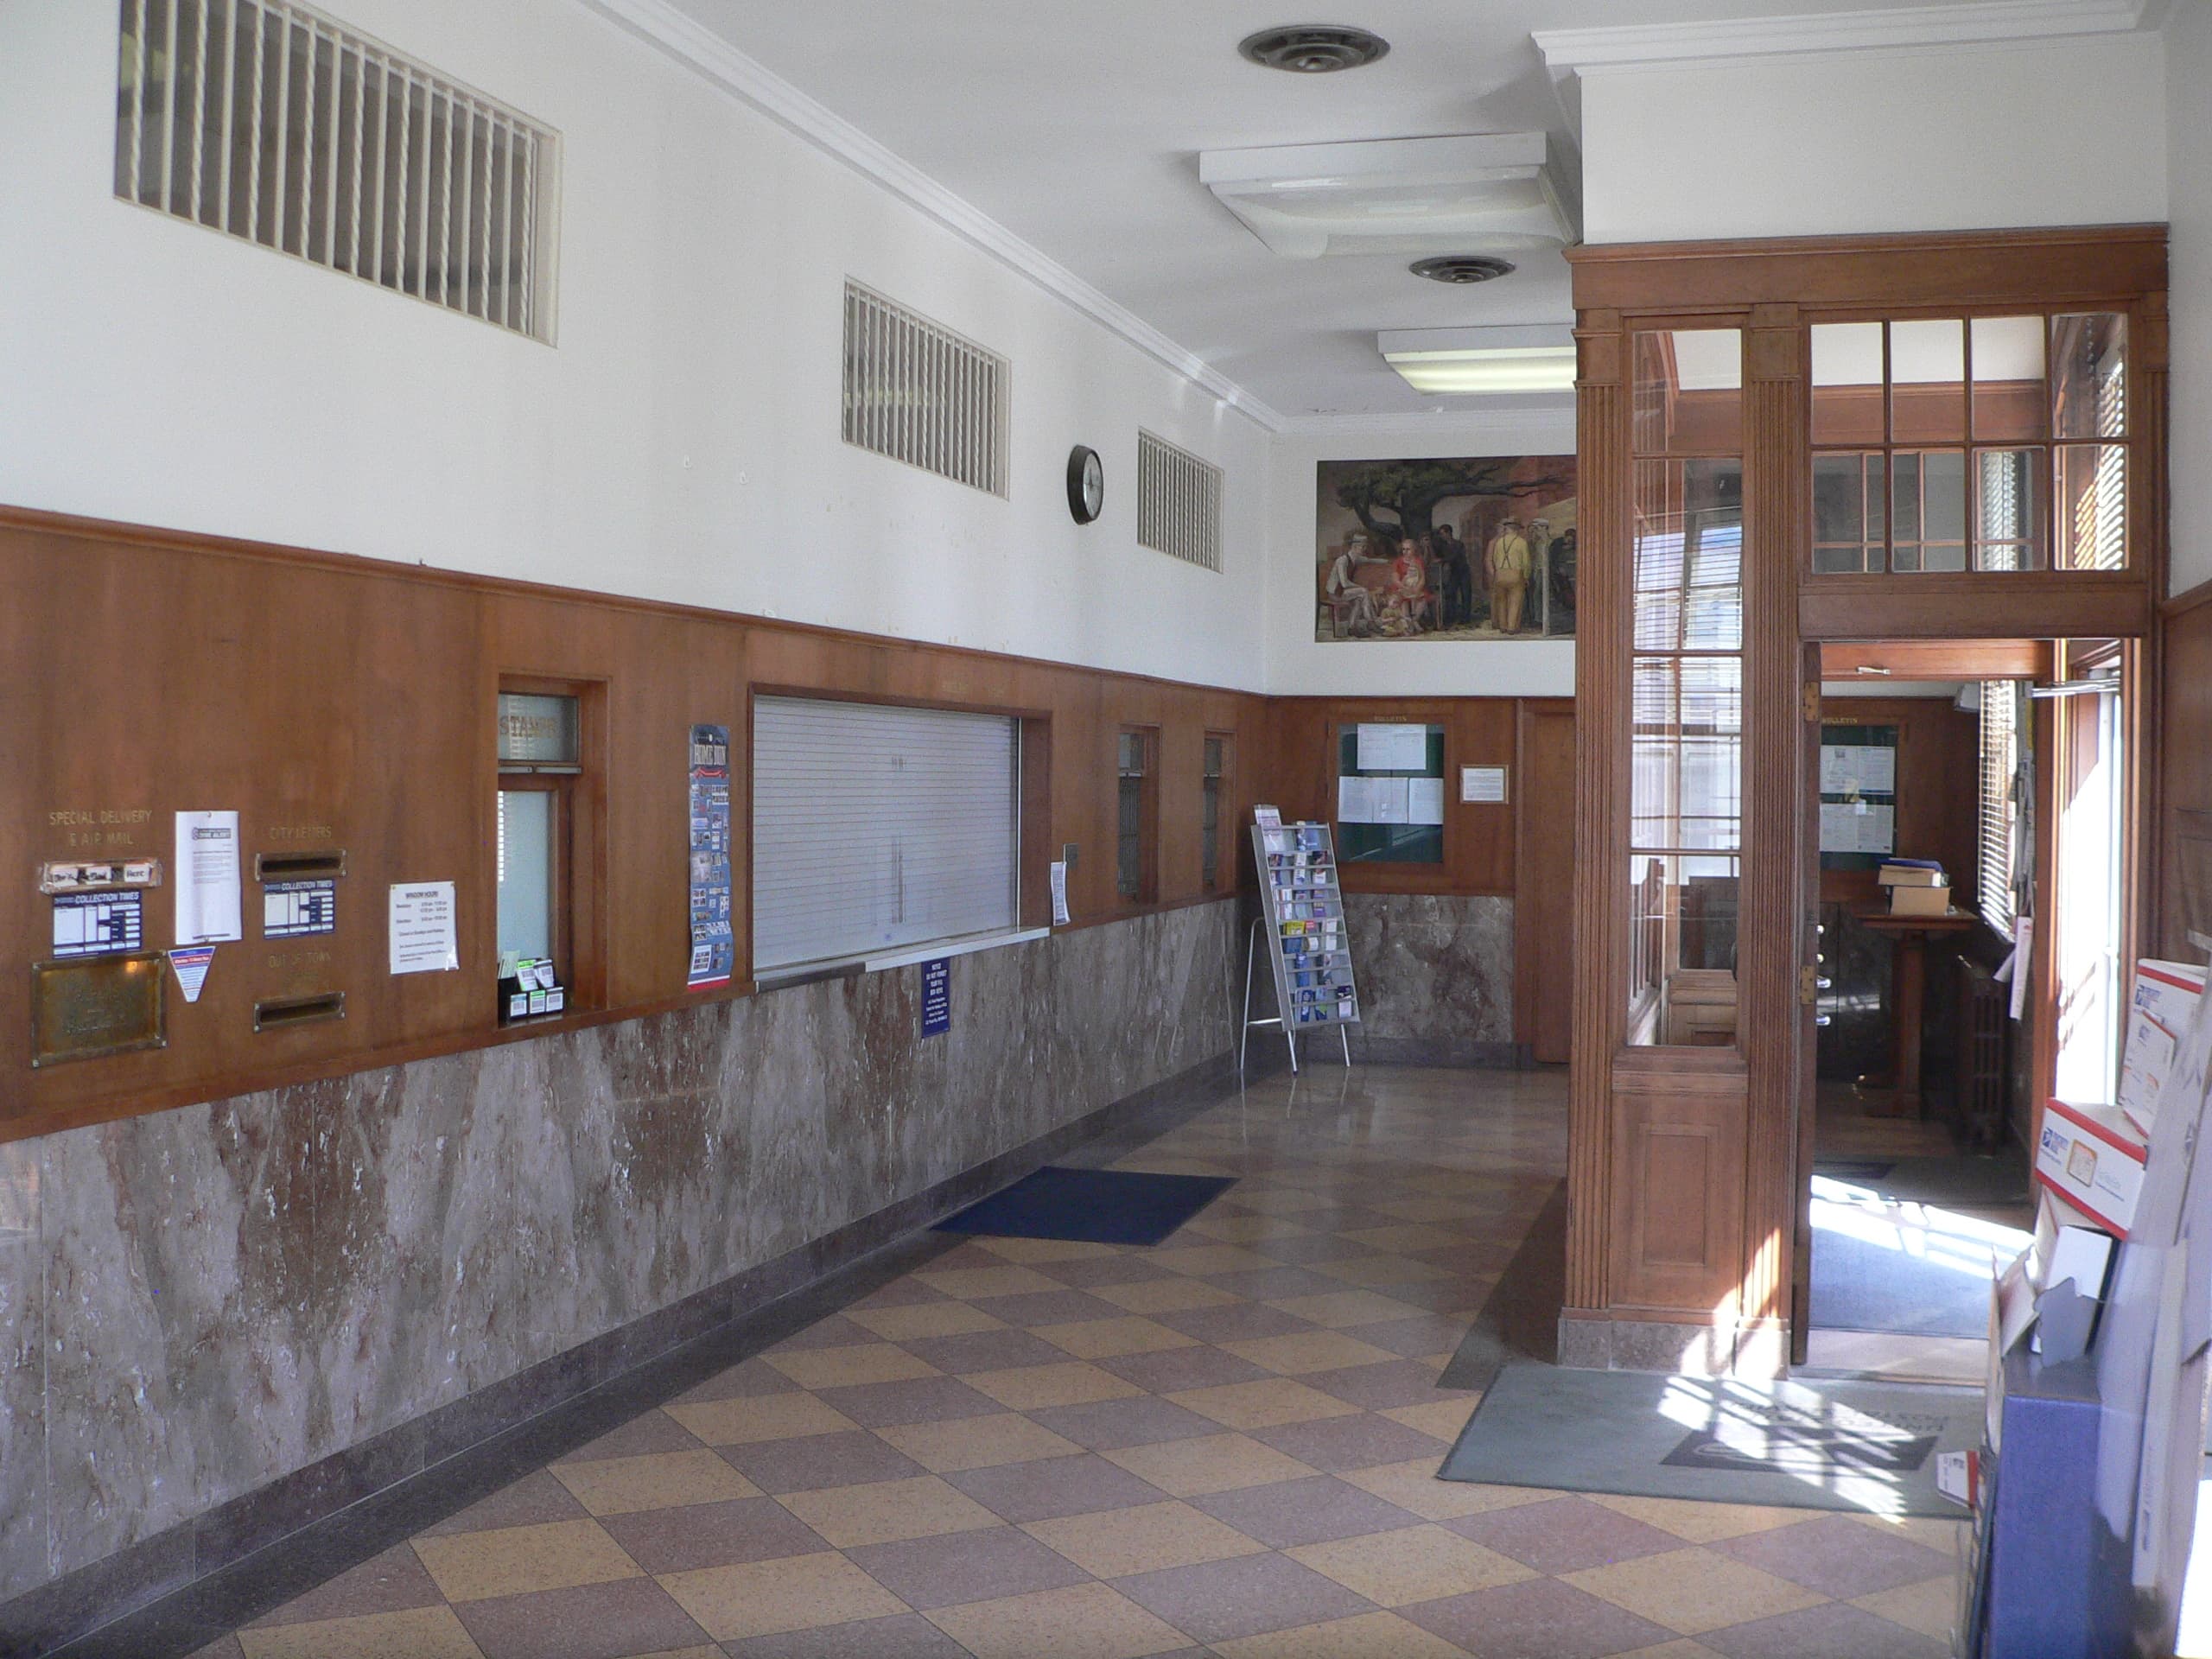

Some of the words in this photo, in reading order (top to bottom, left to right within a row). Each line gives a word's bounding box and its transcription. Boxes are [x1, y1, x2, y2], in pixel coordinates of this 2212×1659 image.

[48, 811, 95, 826] SPECIAL
[100, 810, 153, 823] DELIVERY
[81, 832, 102, 846] AIR
[106, 830, 134, 845] MAIL
[281, 881, 316, 891] COLLECTION
[75, 893, 118, 905] COLLECTION
[119, 891, 140, 901] TIMES
